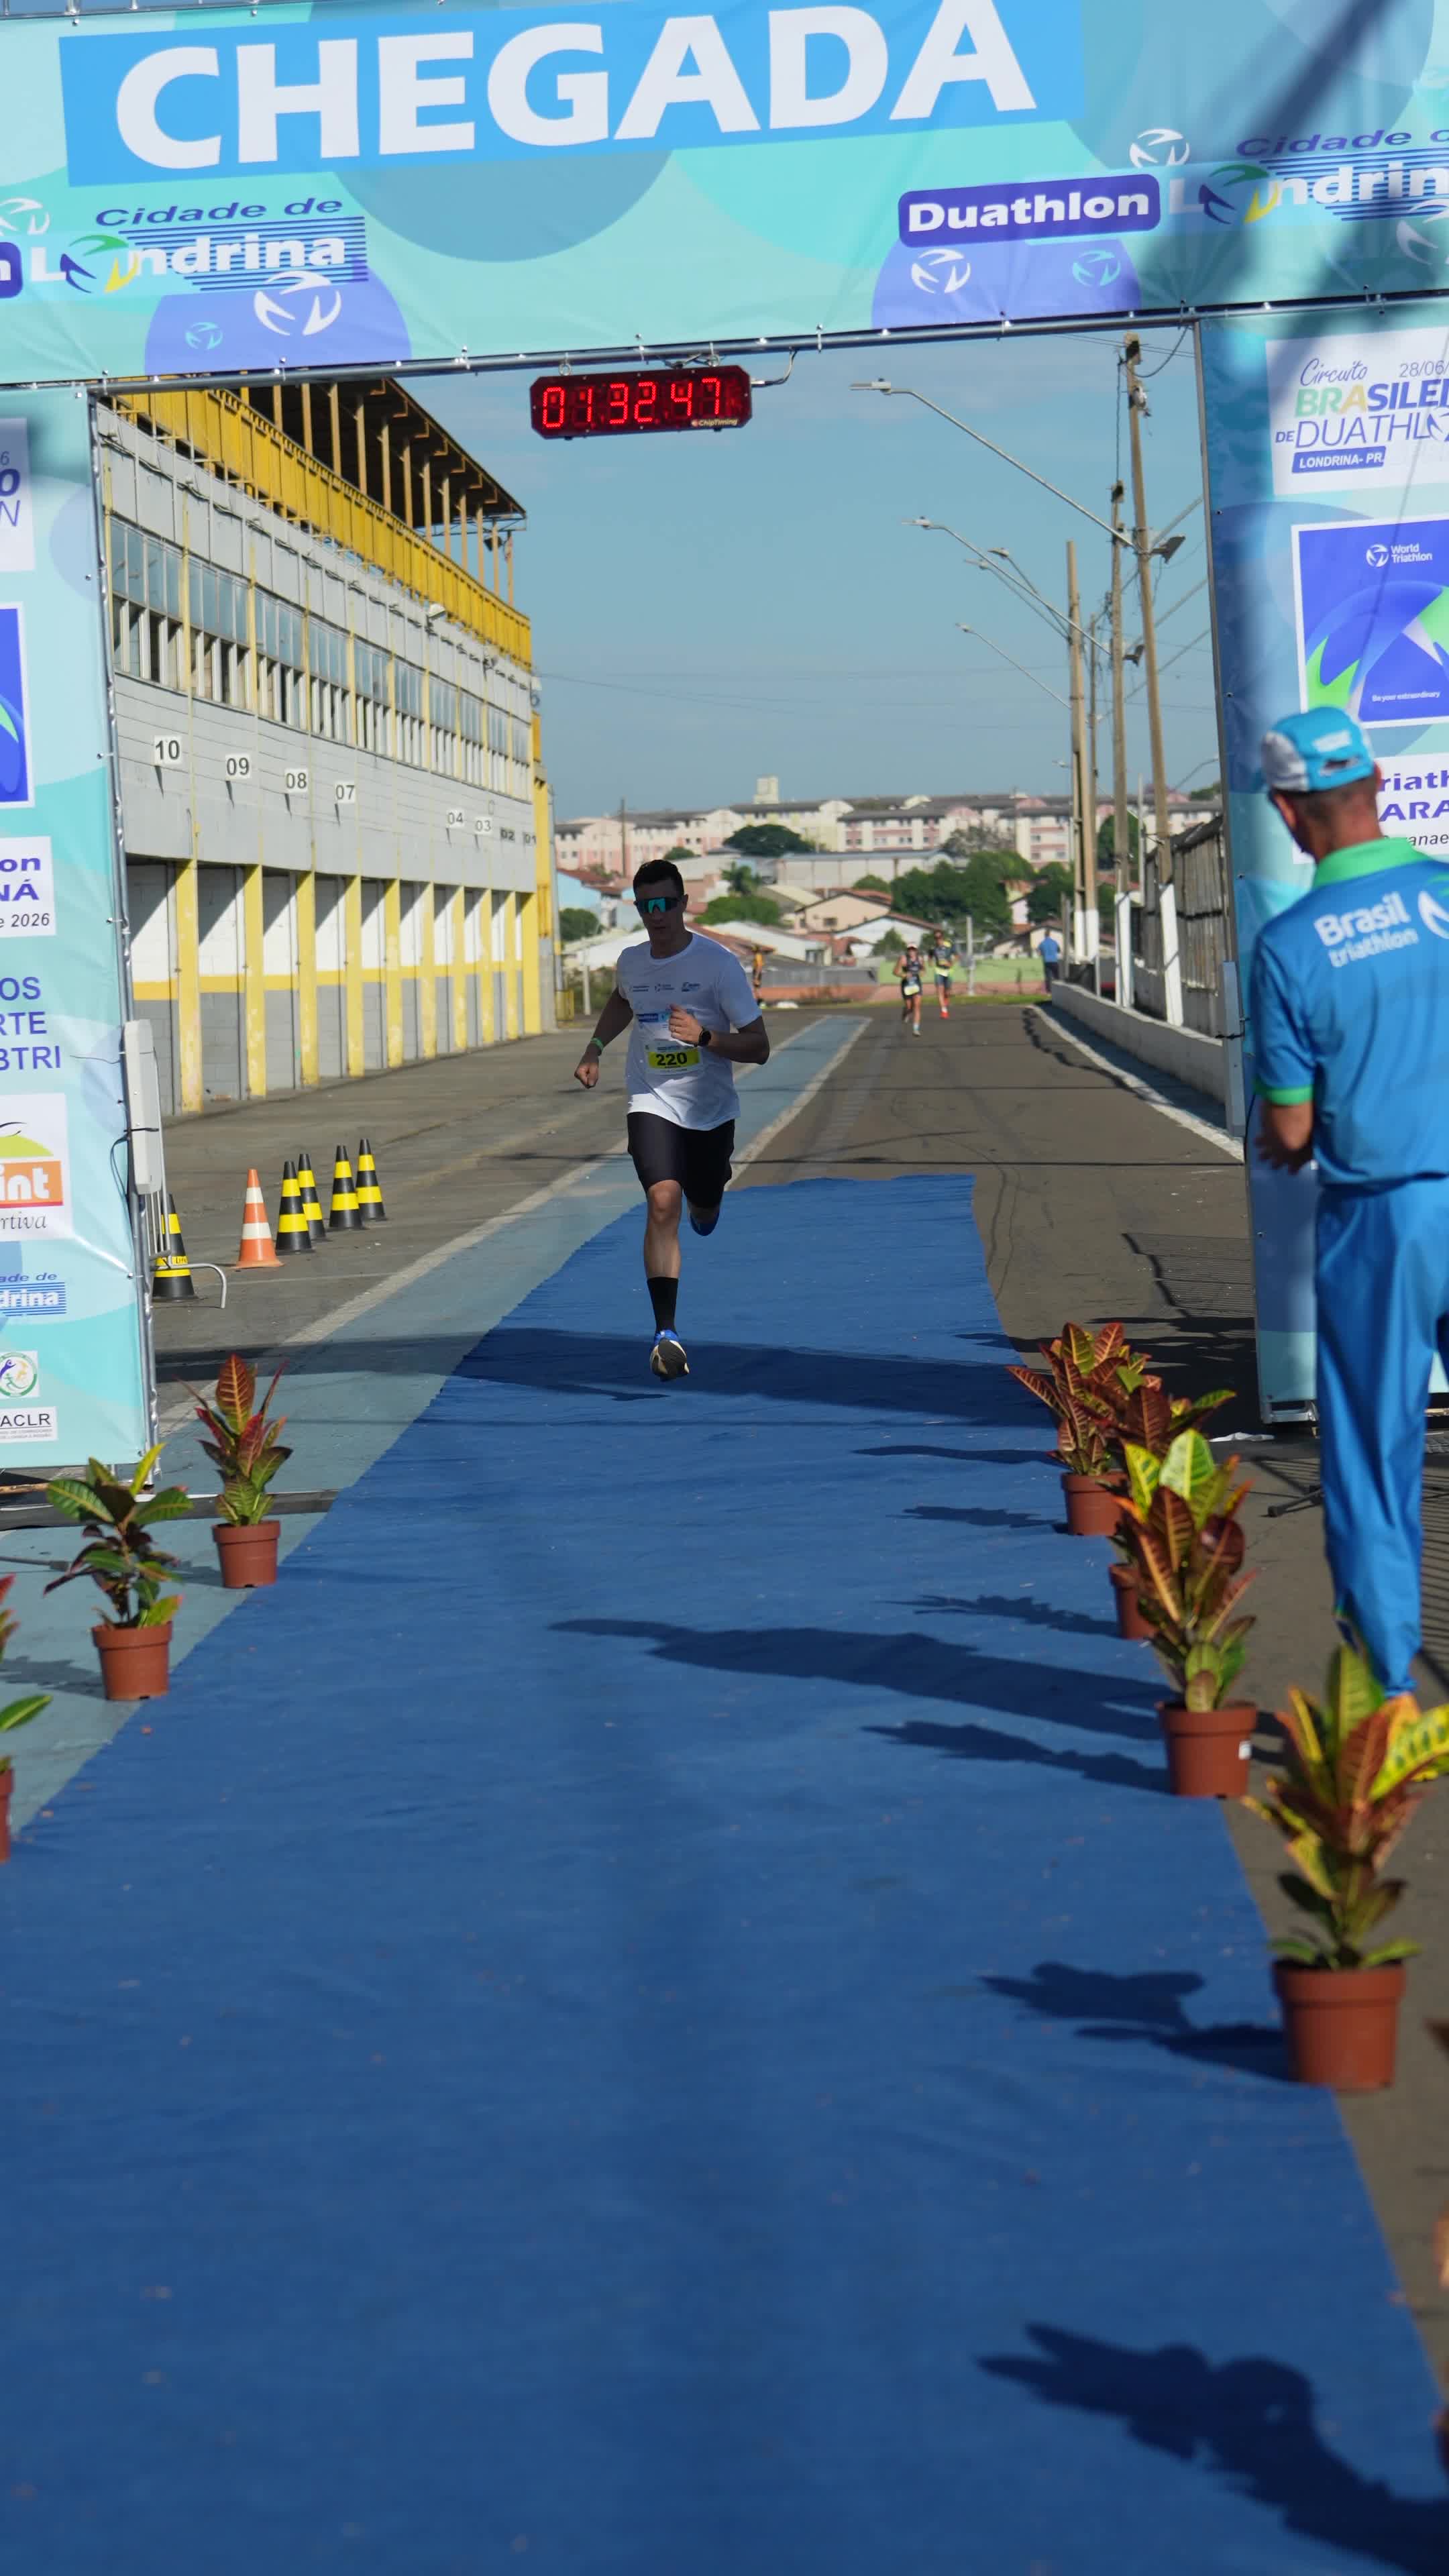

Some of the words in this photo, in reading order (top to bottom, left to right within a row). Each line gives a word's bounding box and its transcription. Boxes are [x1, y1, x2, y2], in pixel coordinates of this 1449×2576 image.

[116, 0, 1037, 170] CHEGADA
[1236, 129, 1412, 158] Cidade
[95, 201, 266, 227] Cidade
[284, 198, 343, 215] de
[908, 191, 1149, 233] Duathlon
[1300, 358, 1368, 386] Circuito
[698, 418, 738, 427] ChipTiming
[1275, 430, 1295, 443] DE
[1391, 543, 1419, 554] World
[1391, 552, 1433, 564] Triathlon
[155, 739, 180, 761] 10
[226, 757, 250, 776] 09
[286, 771, 307, 790] 08
[335, 784, 355, 800] 07
[447, 812, 464, 824] 04
[476, 819, 492, 832] 03
[11, 913, 50, 927] 2026
[1313, 890, 1411, 947] Brasil
[1328, 928, 1419, 968] triathlon
[655, 1052, 688, 1066] 220
[36, 1273, 58, 1281] de
